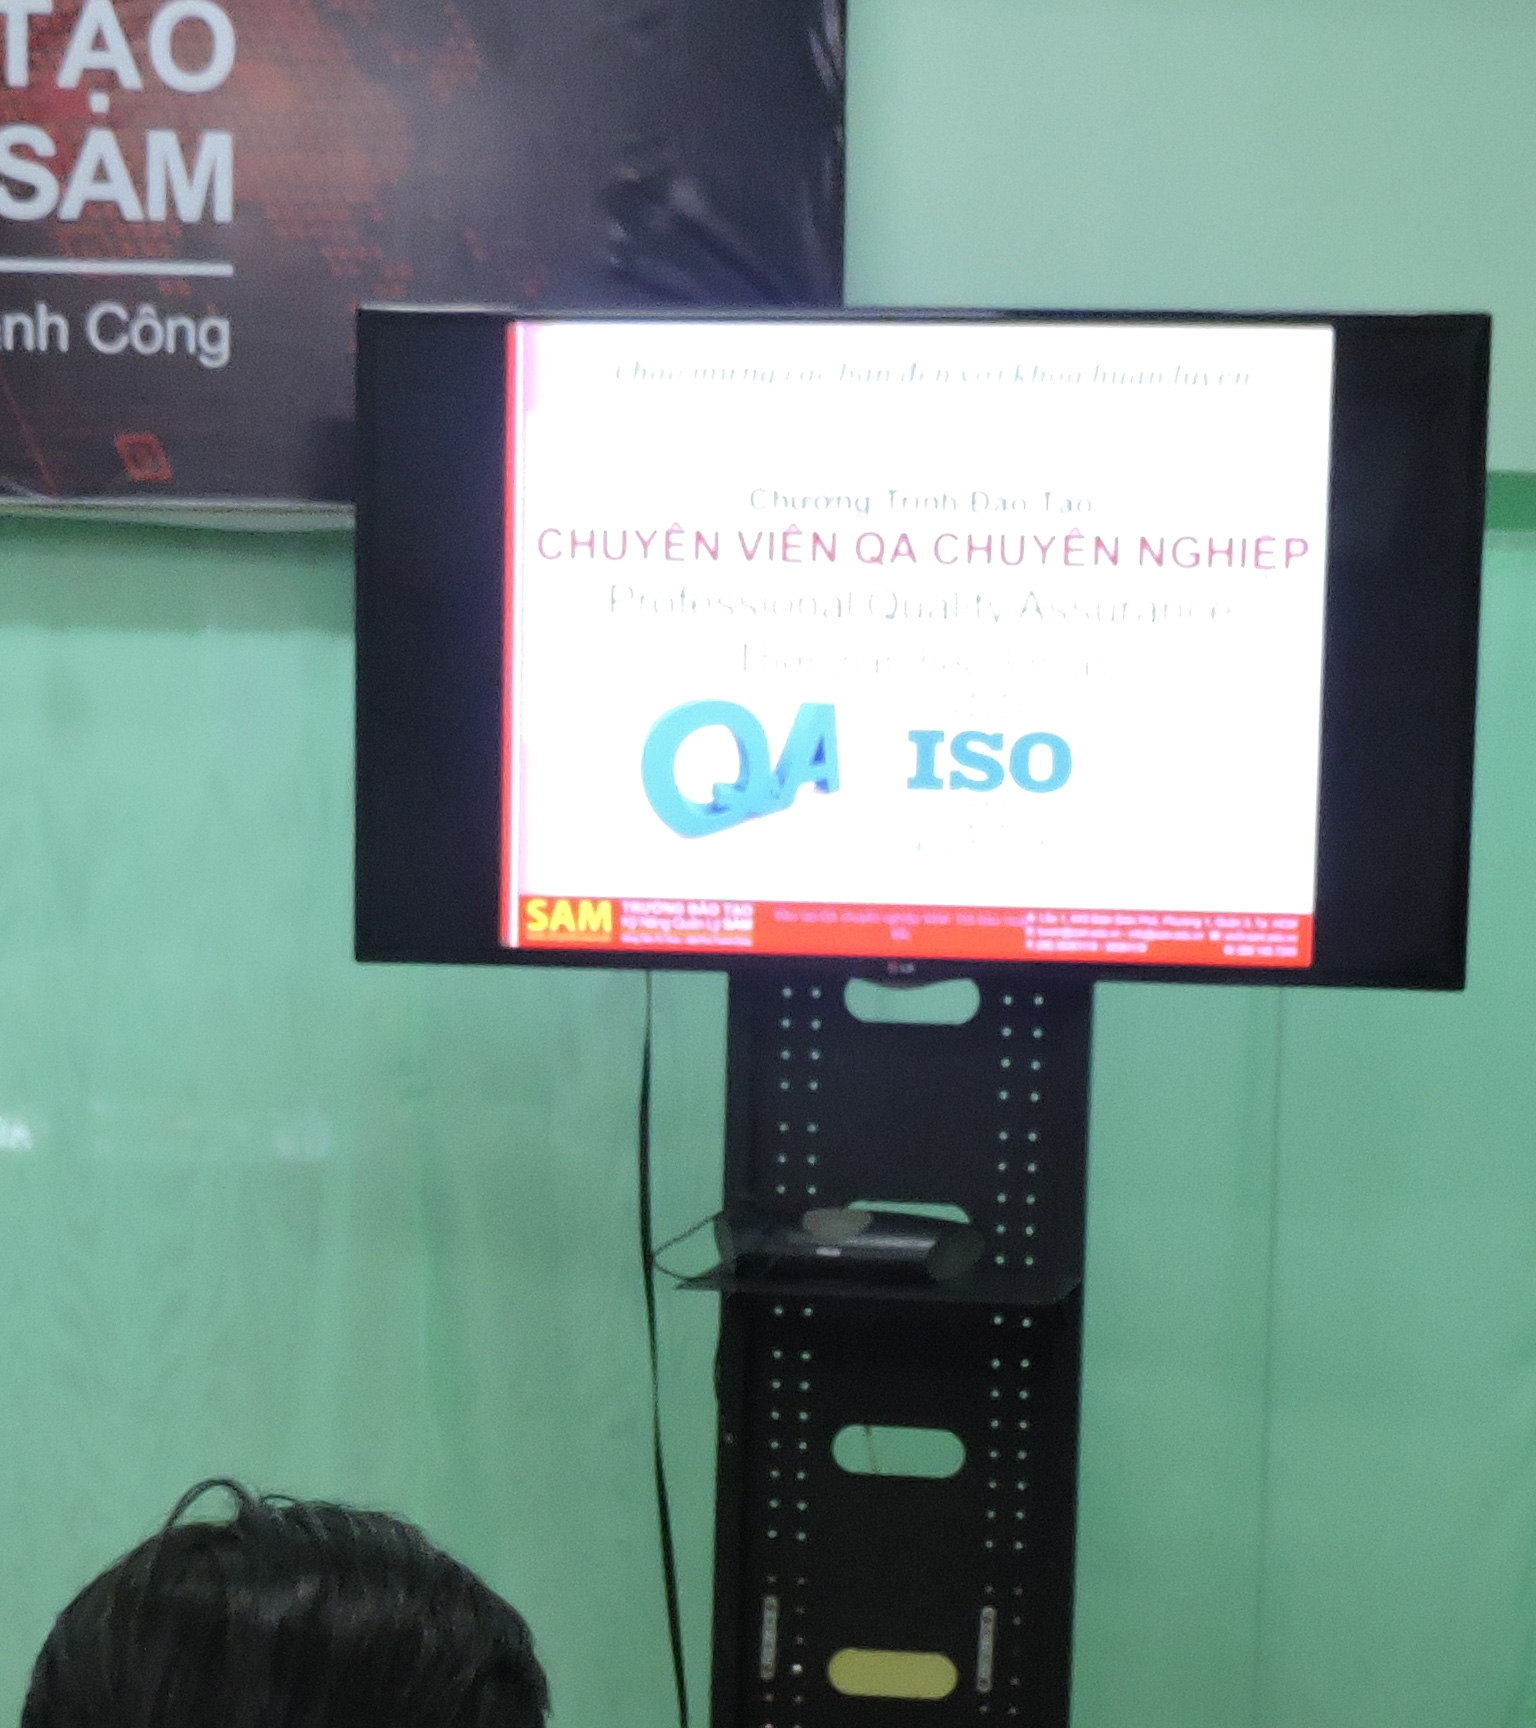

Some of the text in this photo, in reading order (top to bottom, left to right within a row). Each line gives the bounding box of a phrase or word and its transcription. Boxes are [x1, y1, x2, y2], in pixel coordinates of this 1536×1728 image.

[86, 301, 232, 369] Công
[537, 523, 720, 563] CHUYÊN
[737, 523, 838, 564] VIÊN
[855, 531, 918, 566] QA
[933, 527, 1120, 568] CHUYÊN
[641, 698, 841, 840] QA
[906, 729, 1072, 793] ISO
[526, 898, 613, 934] SAM
